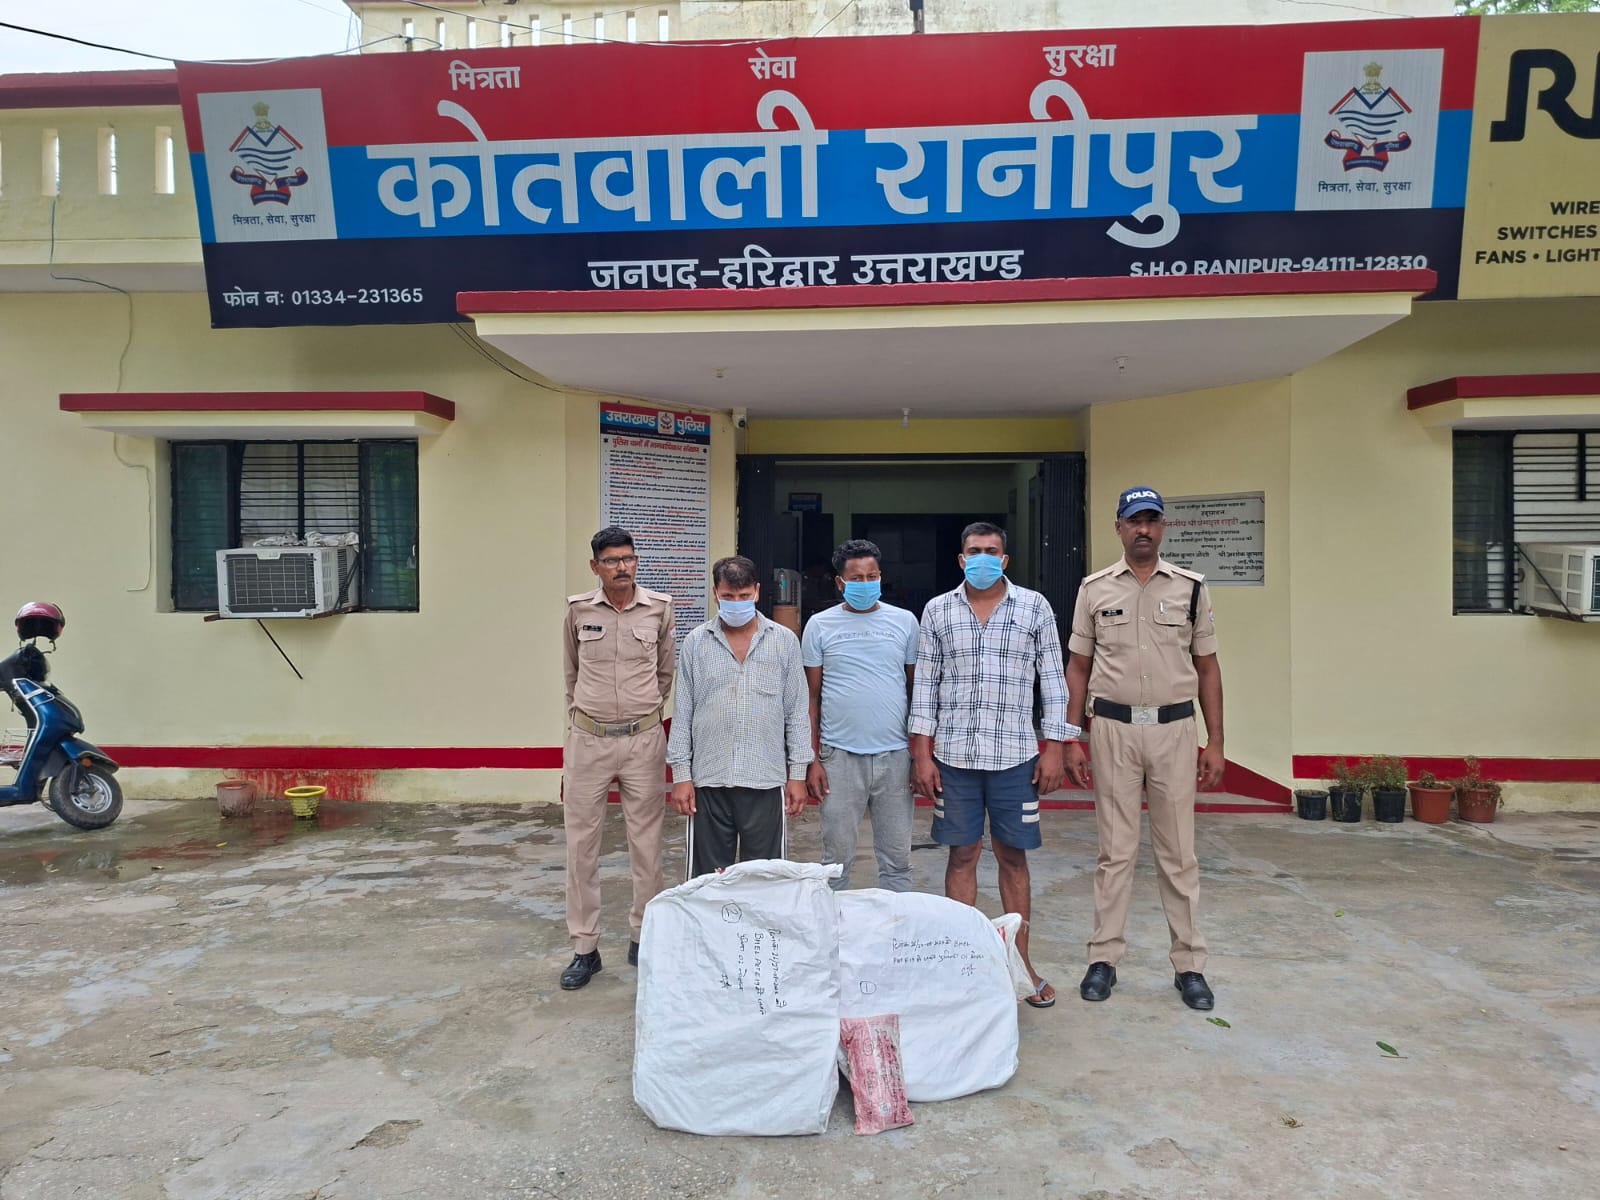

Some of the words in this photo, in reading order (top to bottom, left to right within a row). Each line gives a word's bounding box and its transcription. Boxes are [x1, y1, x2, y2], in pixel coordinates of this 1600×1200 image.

[748, 47, 796, 79] सेवा
[1043, 44, 1117, 76] सुरक्षा
[449, 60, 520, 90] मित्रता
[366, 89, 828, 228] कोतवाली
[865, 79, 1258, 248] रानीपुर
[1383, 181, 1411, 195] सुरक्षा
[290, 213, 317, 227] सुरक्षा
[1497, 224, 1597, 241] SWITCHES
[850, 249, 1025, 284] उत्तराखण्ड
[1130, 260, 1187, 277] S.H.O
[1194, 255, 1427, 275] RANIPUR-94111-12830
[1475, 250, 1527, 265] FANS
[222, 286, 259, 307] फोन
[291, 288, 424, 305] 01334-231365
[605, 410, 657, 428] उत्तराखण्ड
[677, 416, 706, 436] पुलिस
